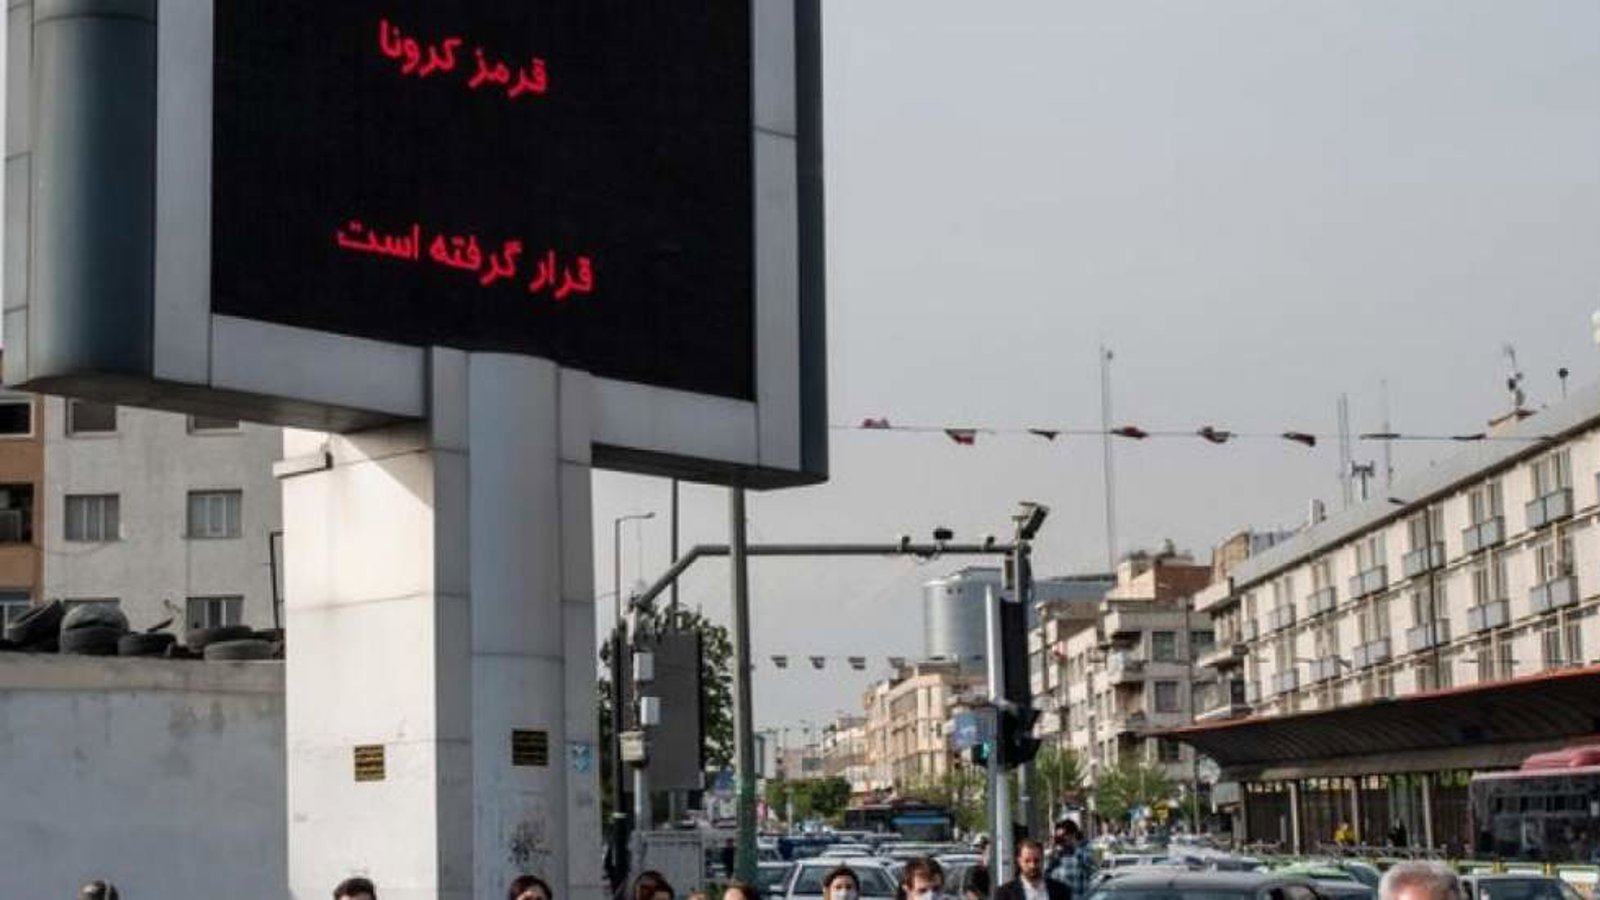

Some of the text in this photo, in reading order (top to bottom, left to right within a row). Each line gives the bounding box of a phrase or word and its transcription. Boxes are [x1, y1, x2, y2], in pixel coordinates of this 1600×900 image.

[378, 19, 548, 97] قرمز کرونا
[337, 219, 594, 299] قرار گرفته است
